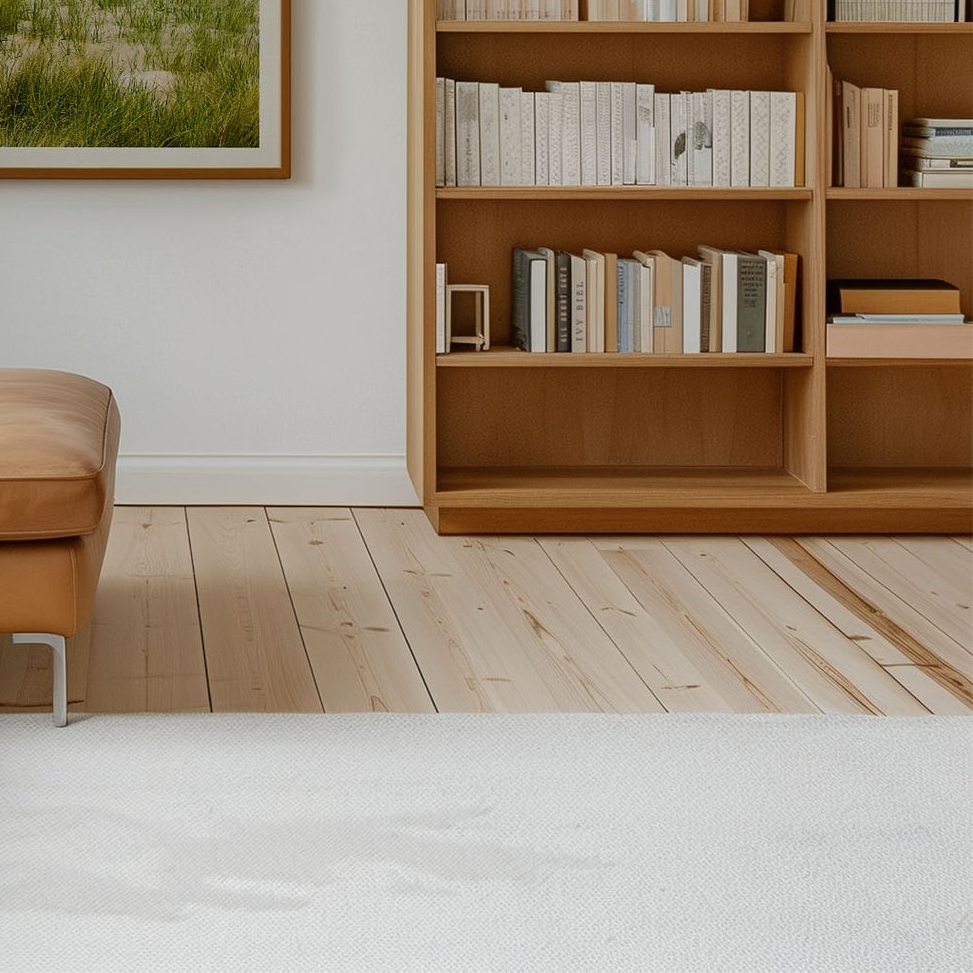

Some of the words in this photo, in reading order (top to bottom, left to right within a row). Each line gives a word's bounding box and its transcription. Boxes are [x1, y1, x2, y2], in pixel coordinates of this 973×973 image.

[560, 294, 568, 322] ABOUT
[575, 281, 584, 311] BIEL
[560, 327, 568, 343] ALL
[575, 318, 583, 342] IVY
